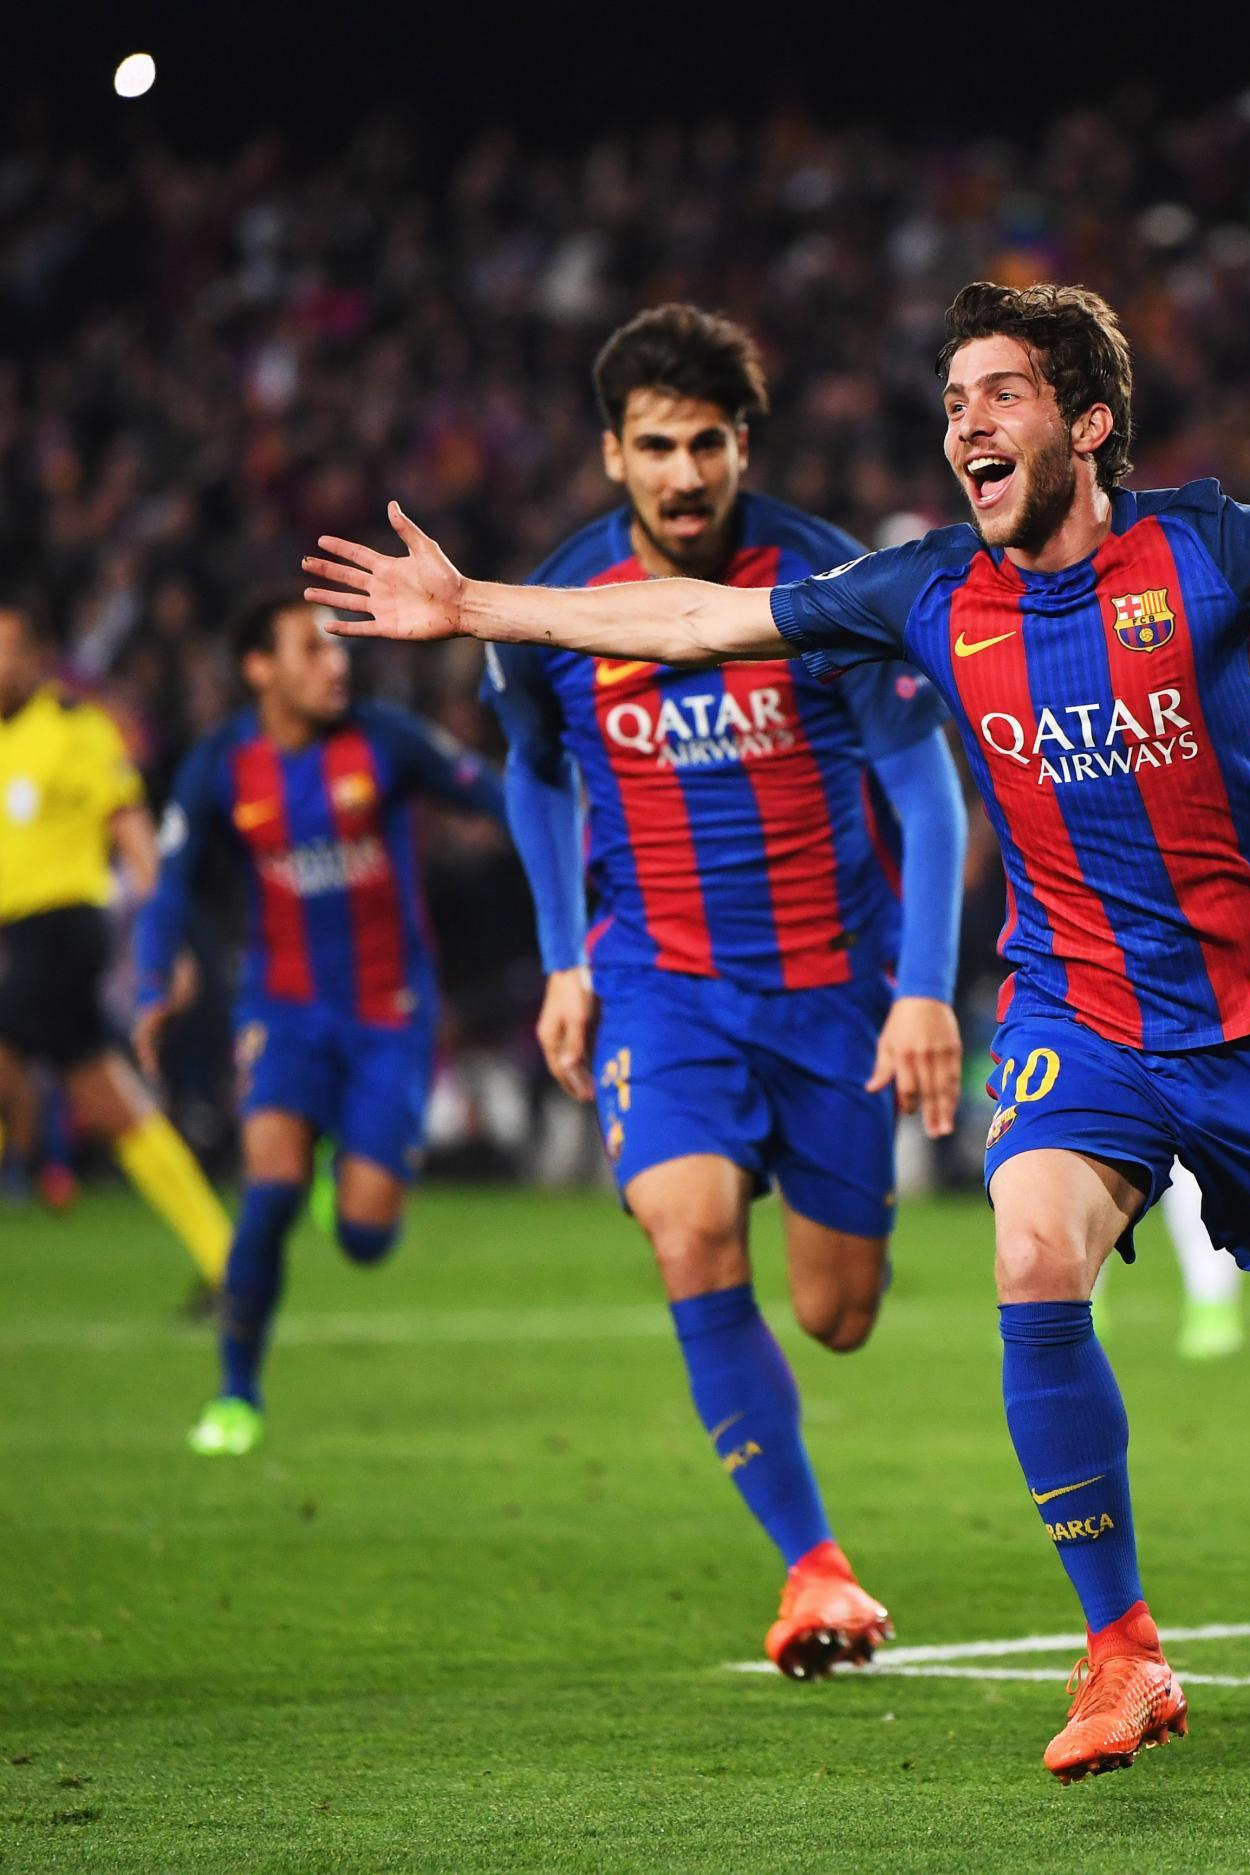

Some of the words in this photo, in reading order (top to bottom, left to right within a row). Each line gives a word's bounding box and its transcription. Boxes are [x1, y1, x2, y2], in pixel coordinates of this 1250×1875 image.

[606, 687, 787, 755] QATAR
[656, 730, 795, 768] AIRWAYS
[980, 688, 1191, 765] QATAR
[1037, 730, 1199, 785] AIRWAYS
